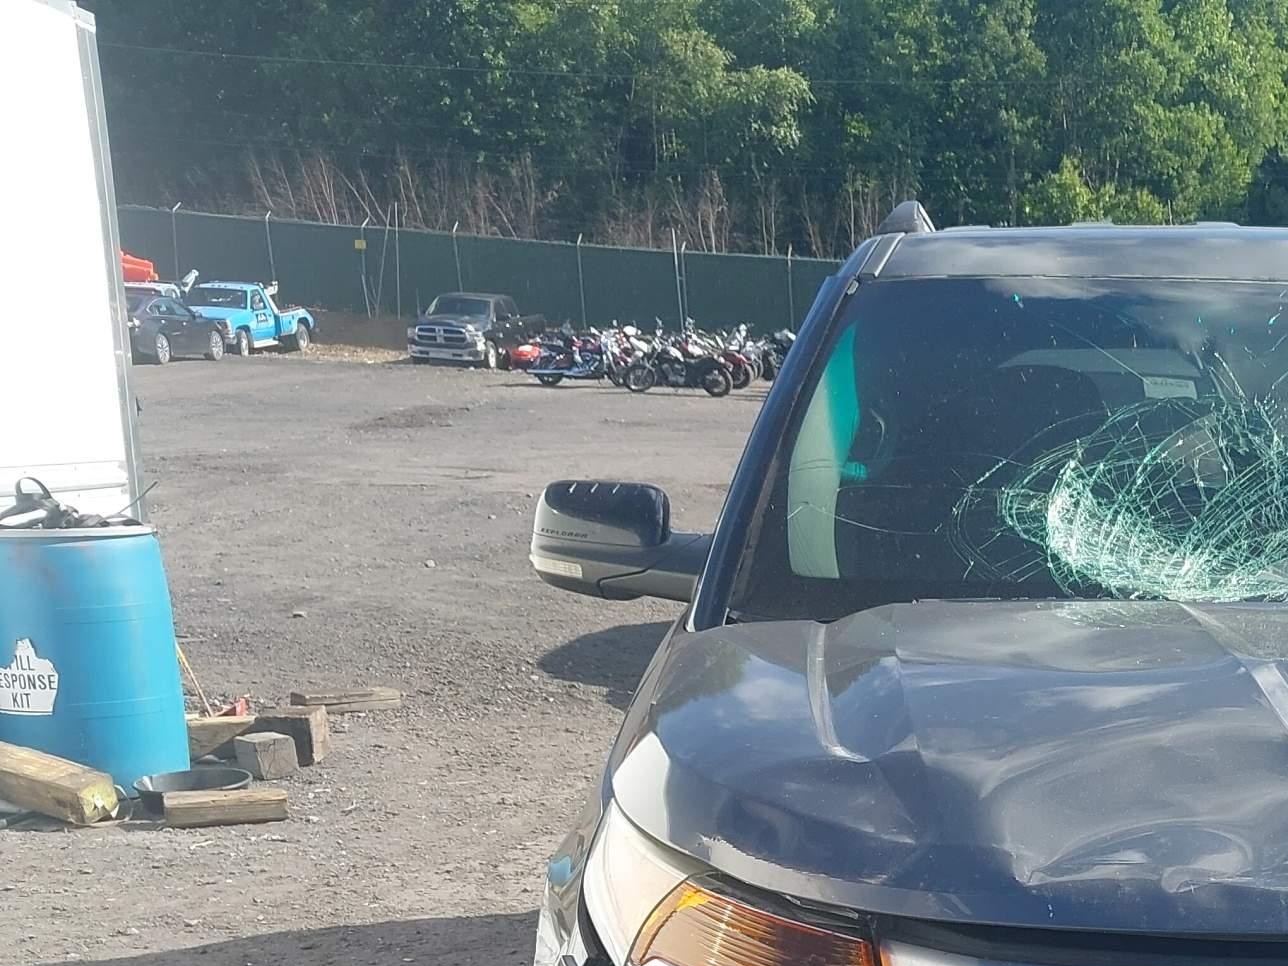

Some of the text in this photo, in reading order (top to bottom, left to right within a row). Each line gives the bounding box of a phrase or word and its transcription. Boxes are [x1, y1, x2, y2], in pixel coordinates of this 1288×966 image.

[14, 654, 36, 671] ILL
[0, 672, 58, 690] ESPONSE
[11, 692, 32, 709] KIT
